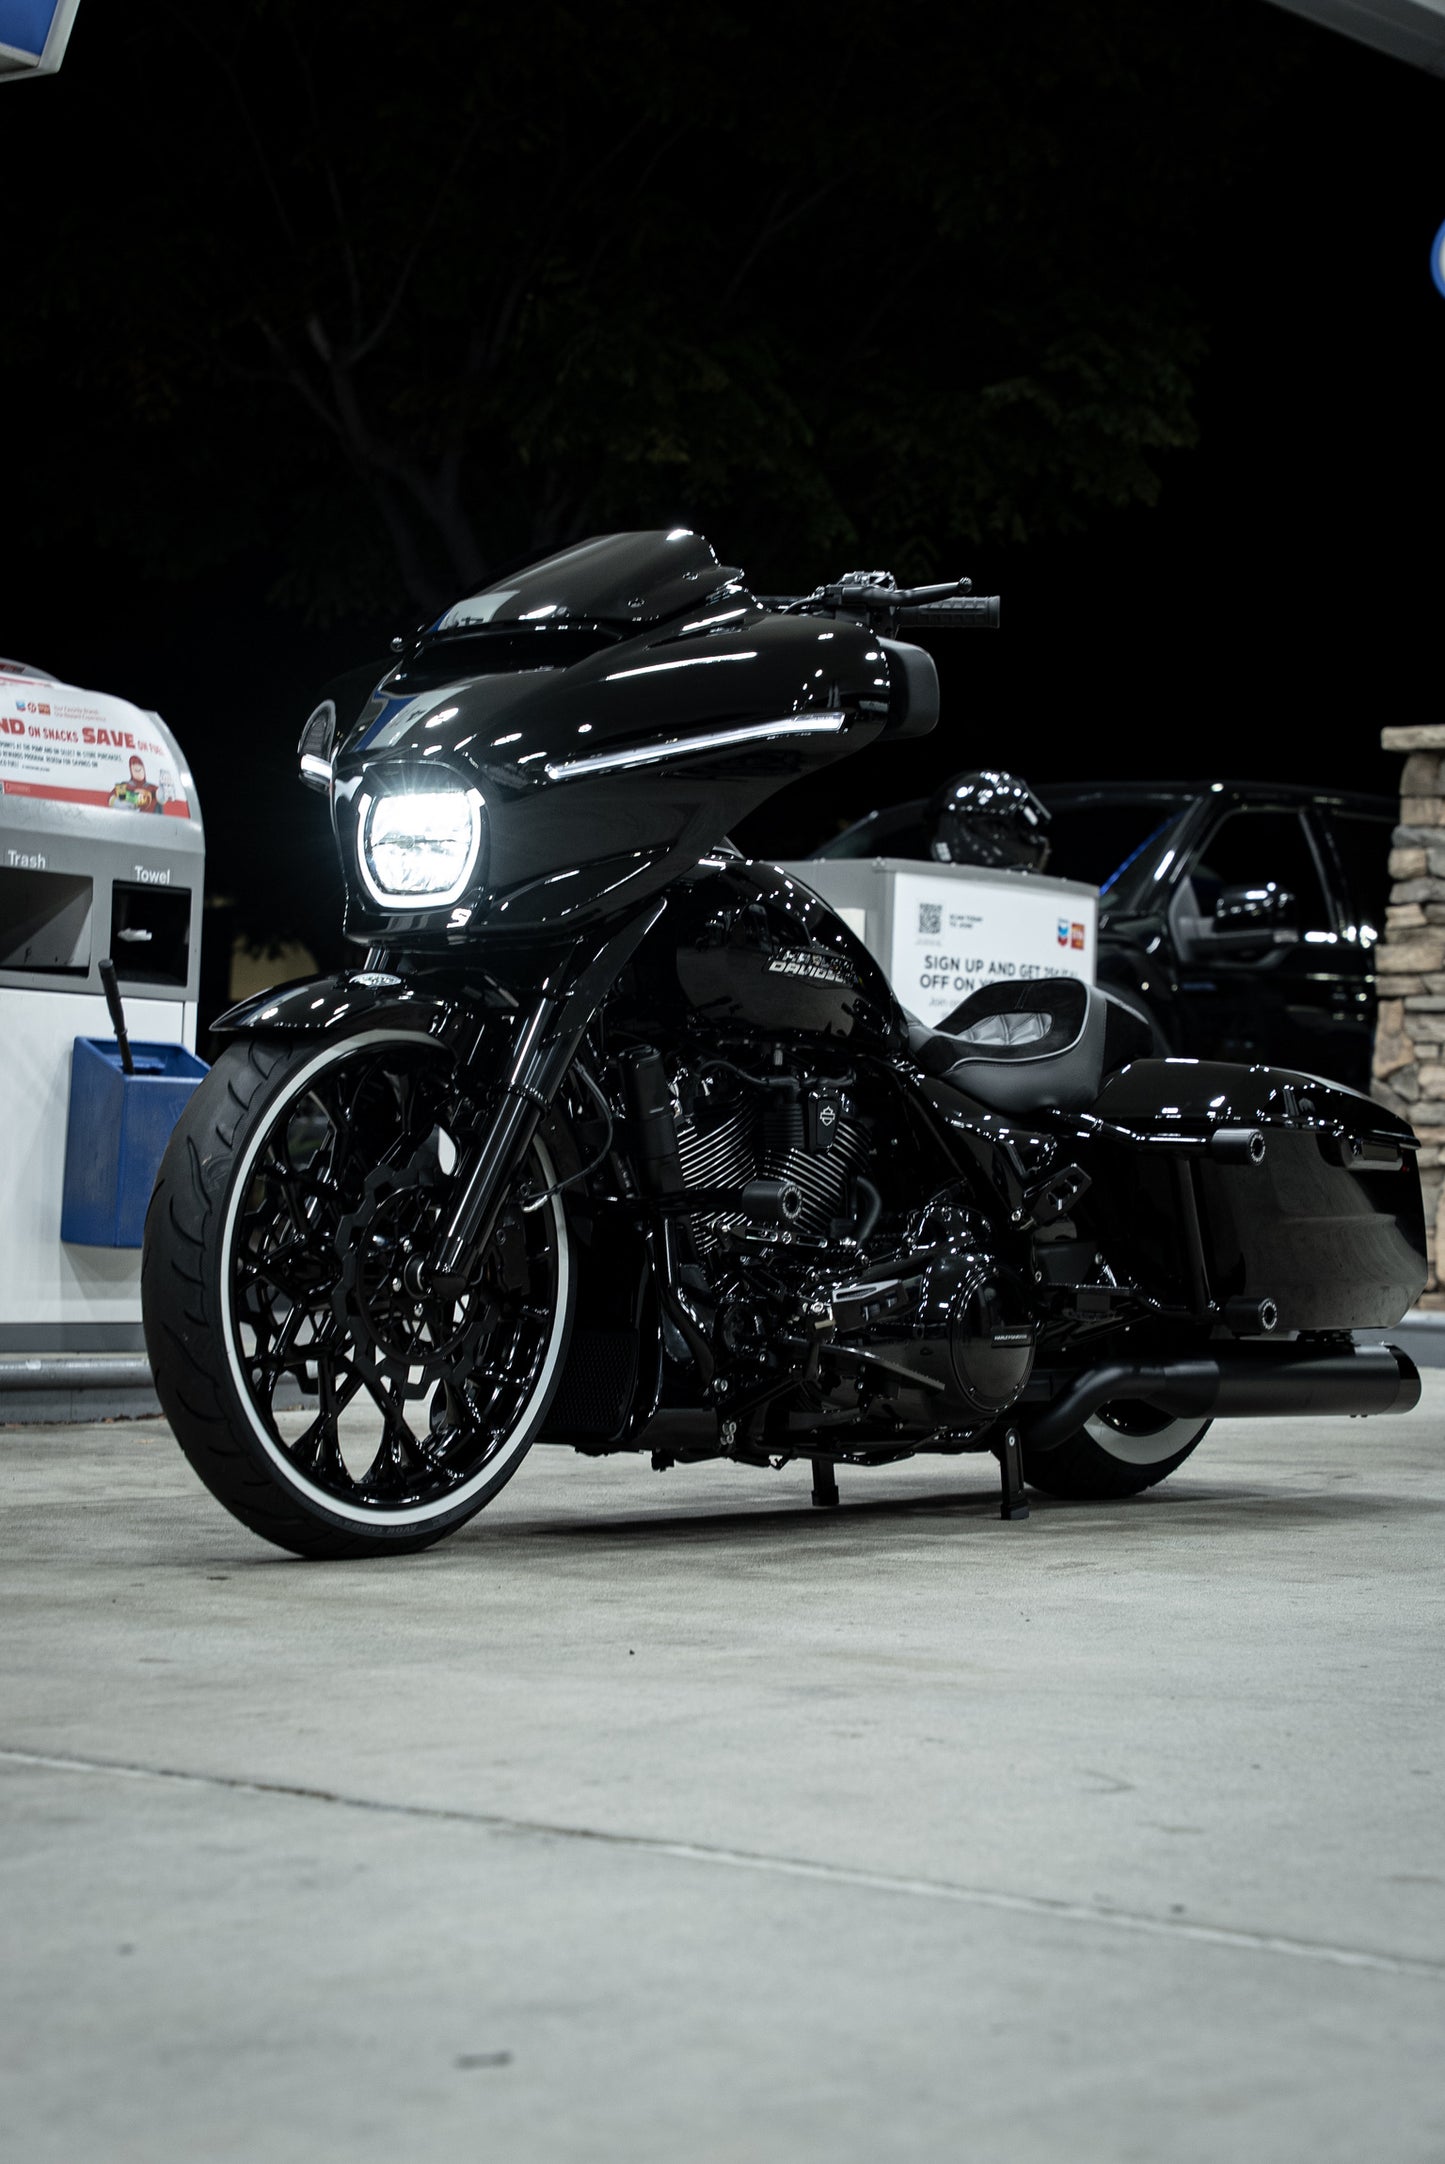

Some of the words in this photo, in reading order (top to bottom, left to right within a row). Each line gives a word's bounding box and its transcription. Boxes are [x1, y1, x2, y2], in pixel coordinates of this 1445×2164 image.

[28, 726, 41, 737] ON
[43, 728, 79, 743] SNACKS
[82, 727, 136, 749] SAVE
[8, 850, 46, 870] Trash
[134, 865, 171, 885] Towel
[924, 954, 961, 971] SIGN
[965, 958, 984, 973] UP
[988, 961, 1016, 977] AND
[1019, 963, 1041, 979] GET
[920, 974, 949, 989] OFF
[954, 977, 975, 992] ON
